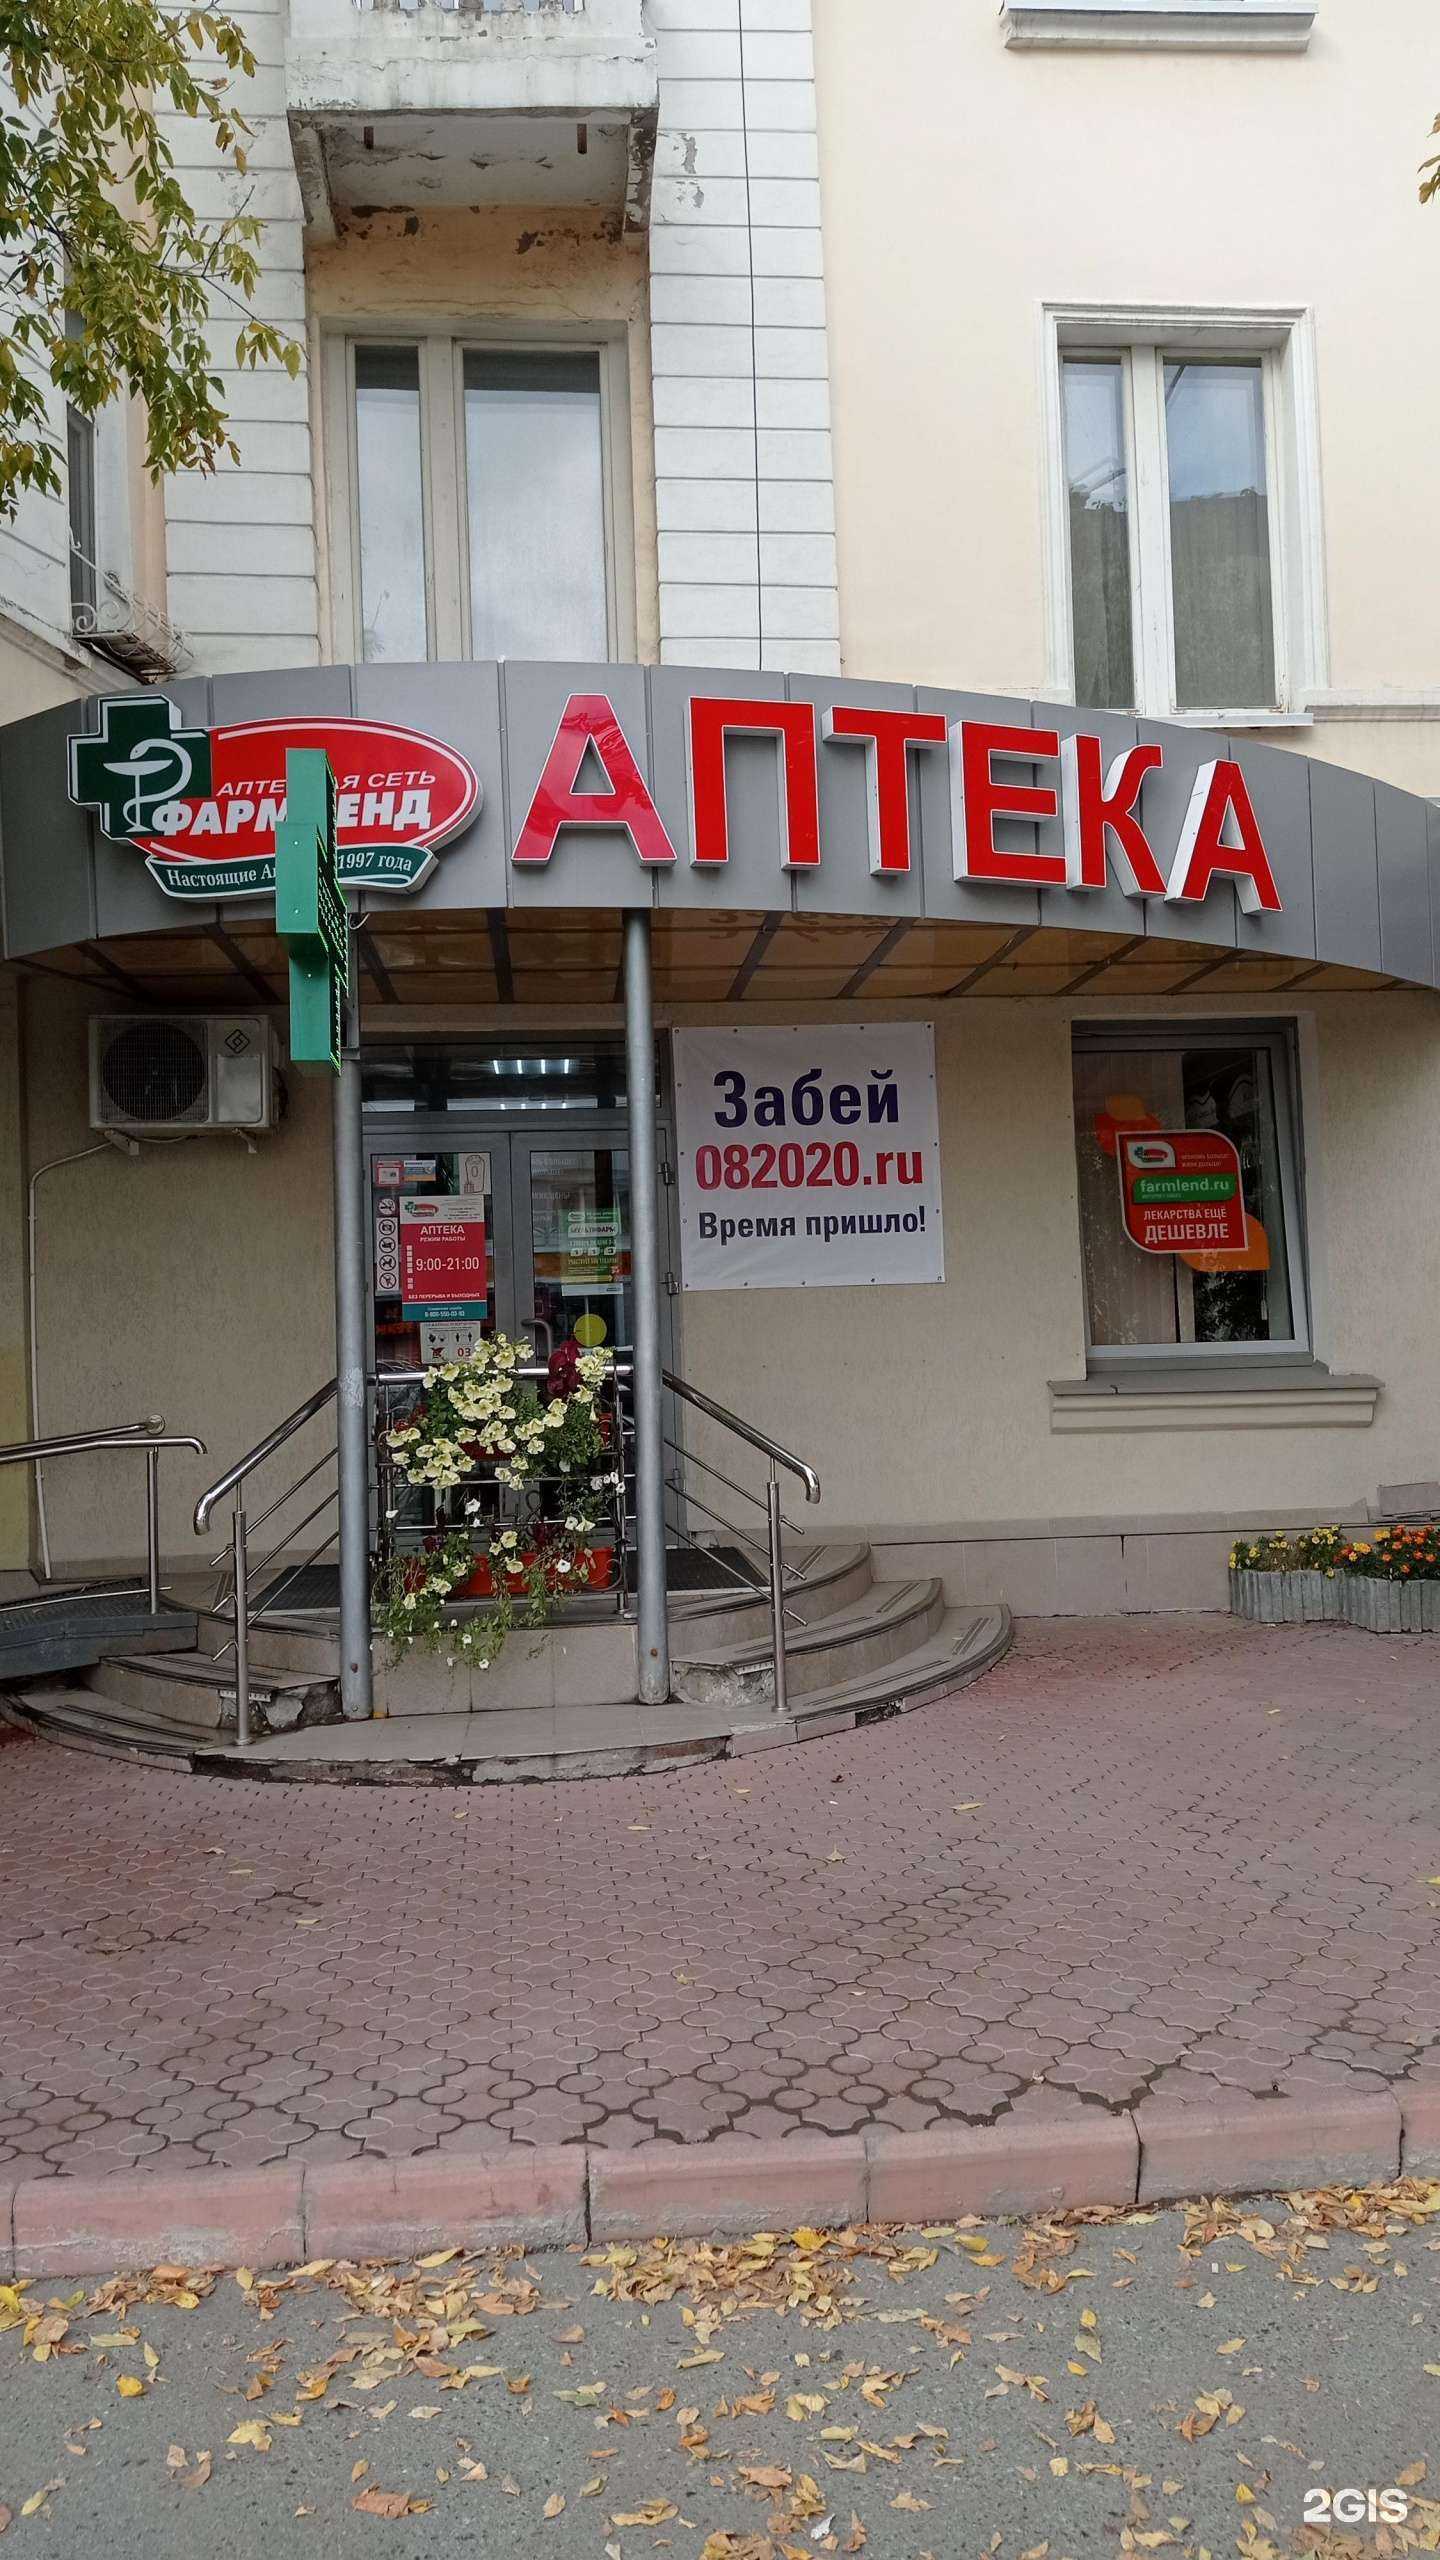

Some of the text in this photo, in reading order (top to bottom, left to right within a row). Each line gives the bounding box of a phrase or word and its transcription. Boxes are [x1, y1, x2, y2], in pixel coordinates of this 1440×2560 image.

[216, 771, 436, 797] АПТЕЯ СЕТЬ
[152, 789, 431, 836] ФАРМЕНД
[511, 693, 1283, 915] АПТЕКА
[166, 868, 257, 887] Настоящие
[338, 852, 375, 870] 1997
[378, 854, 412, 872] года
[713, 1068, 899, 1128] Забей
[695, 1141, 923, 1190] 082020.ru
[1140, 1178, 1229, 1193] farmlend.ru
[699, 1205, 926, 1246] Время пришло!
[1144, 1208, 1227, 1220] ЛЕКАРСТВА ЕЩЕ
[420, 1224, 465, 1235] АПТЕКА
[1145, 1223, 1230, 1244] ДЕШЕВЛЕ
[416, 1257, 480, 1271] 9:00-21:00
[457, 1347, 471, 1357] 03
